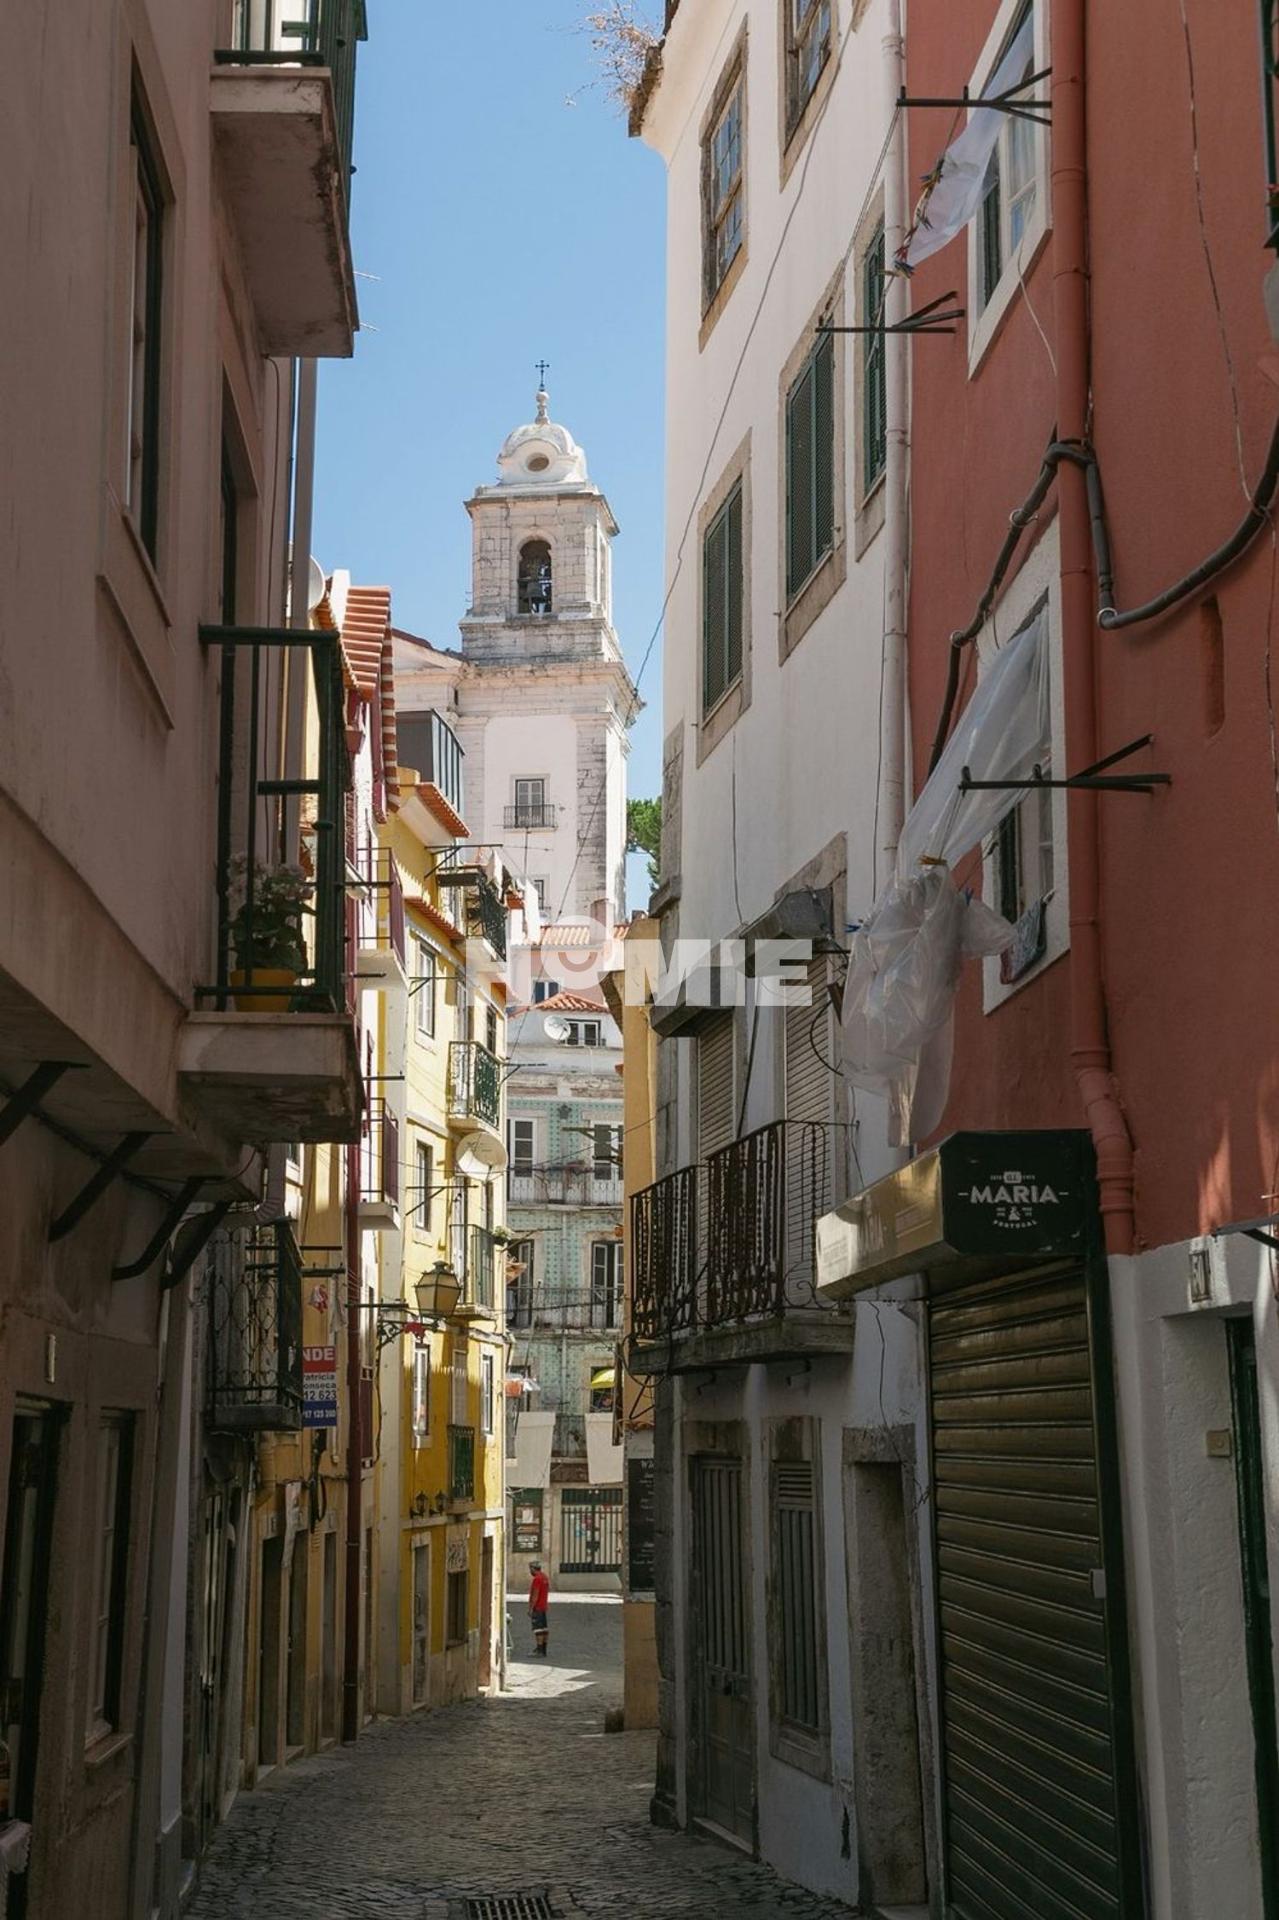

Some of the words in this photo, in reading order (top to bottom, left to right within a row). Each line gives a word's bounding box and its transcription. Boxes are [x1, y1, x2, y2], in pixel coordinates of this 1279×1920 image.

[970, 1184, 1060, 1204] MARIA
[303, 1373, 335, 1381] atricia
[319, 1390, 337, 1400] 623
